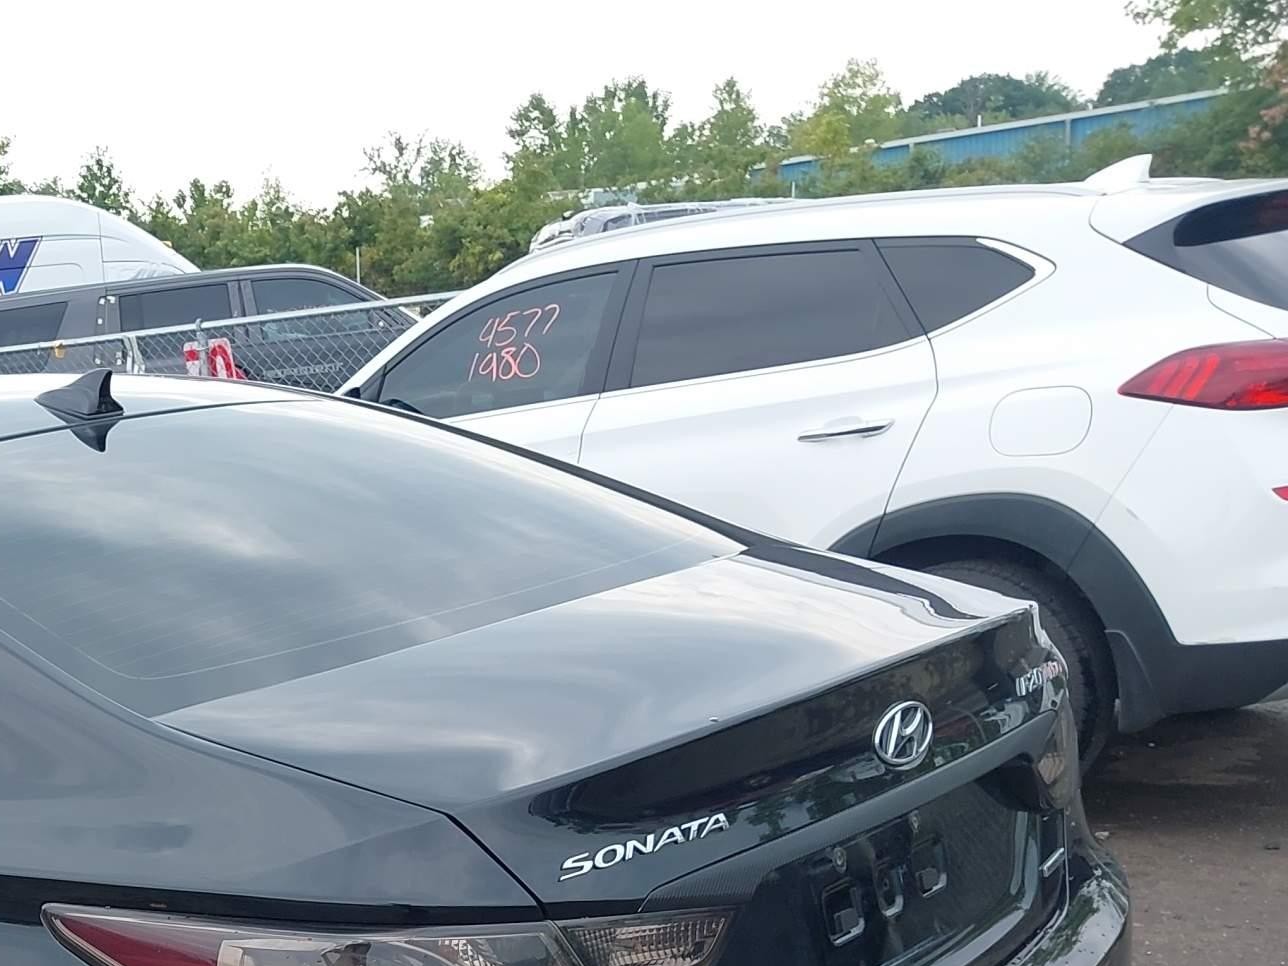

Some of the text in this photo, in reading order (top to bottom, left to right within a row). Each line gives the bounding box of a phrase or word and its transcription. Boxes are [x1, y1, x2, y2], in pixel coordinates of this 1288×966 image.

[478, 303, 561, 349] 4577
[467, 342, 541, 382] 1980
[558, 812, 730, 882] SONATA
